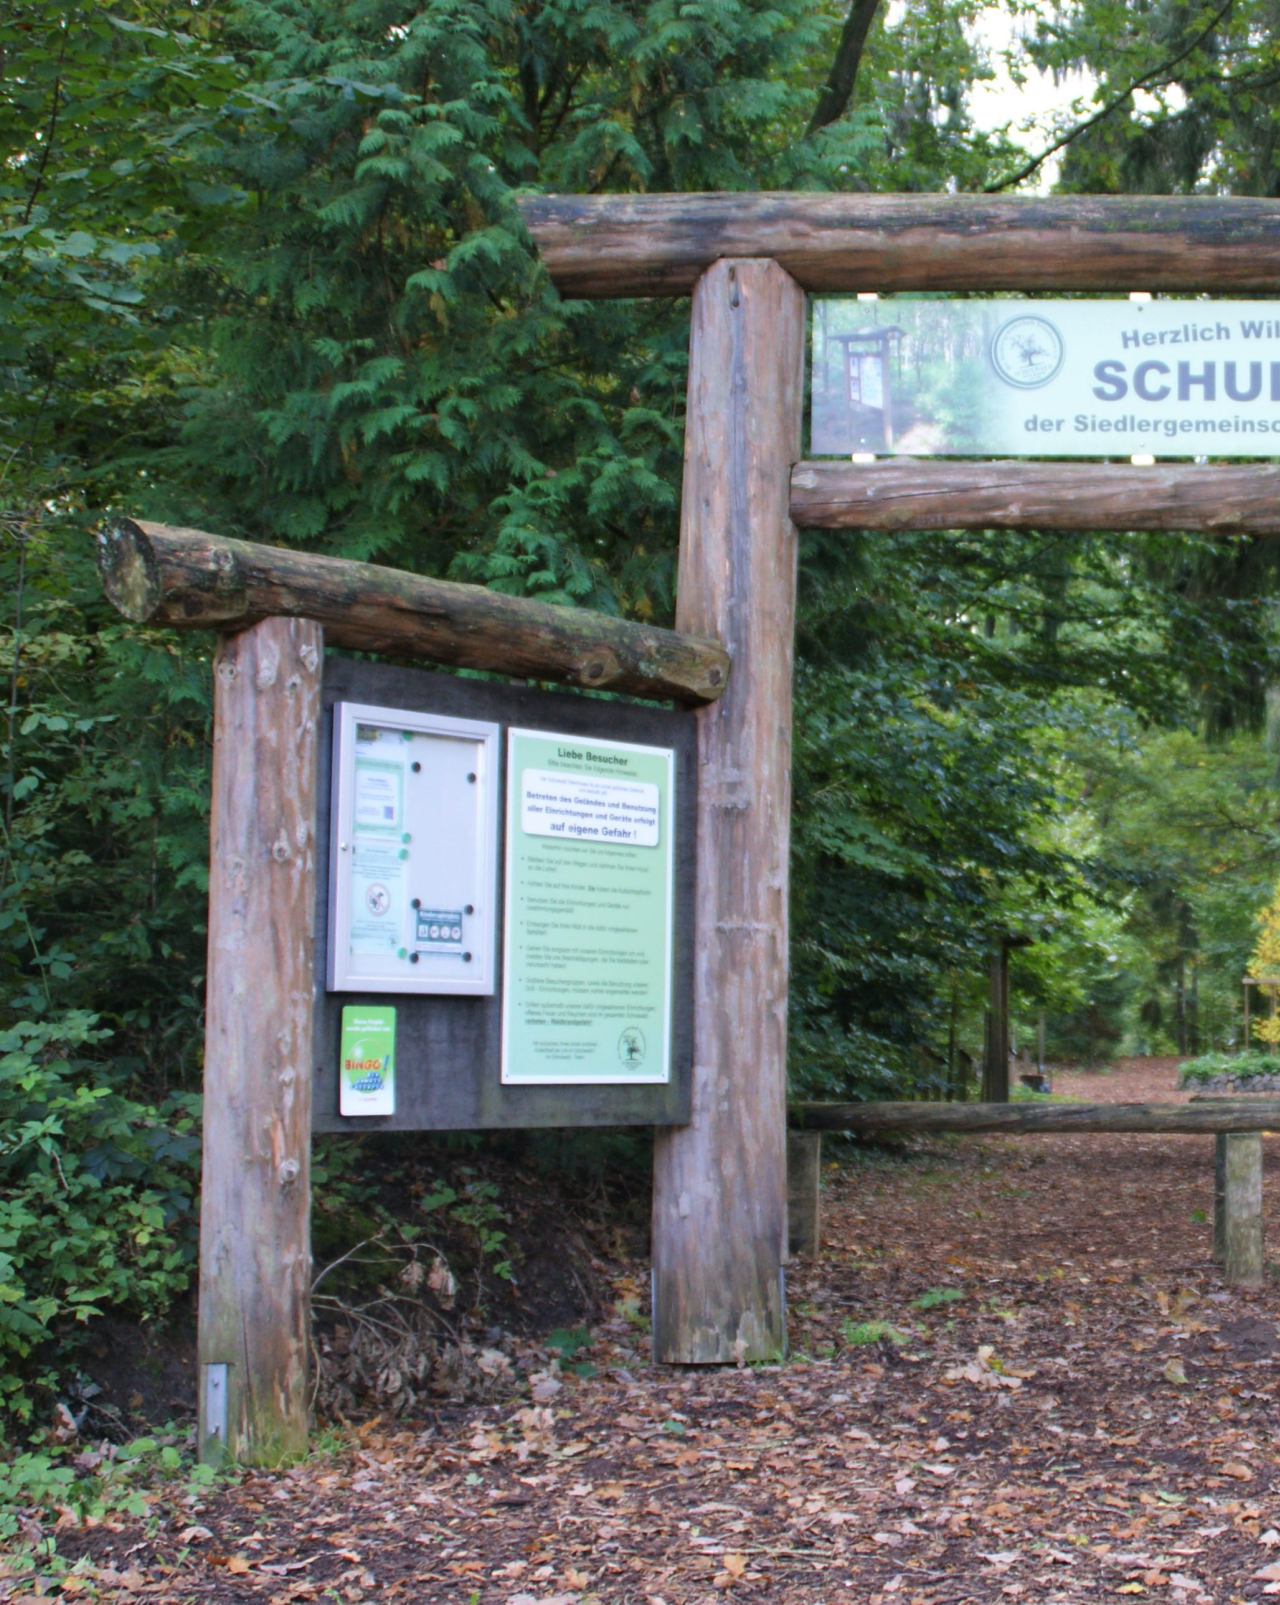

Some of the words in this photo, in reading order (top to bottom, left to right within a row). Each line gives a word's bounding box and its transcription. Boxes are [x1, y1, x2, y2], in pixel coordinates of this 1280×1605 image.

[1121, 321, 1231, 349] Herzlich
[1024, 413, 1066, 434] der
[557, 748, 583, 760] Liebe
[586, 751, 628, 766] Besucher
[526, 791, 557, 801] Betreten
[574, 797, 605, 807] Geländes
[607, 801, 620, 809] und
[622, 802, 656, 814] Benutzung
[527, 805, 543, 813] aller
[545, 806, 593, 819] Einrichtungen
[595, 812, 607, 820] und
[609, 813, 632, 823] Geräte
[634, 817, 655, 827] erfolgt
[550, 822, 565, 831] auf
[568, 824, 599, 835] eigene
[602, 827, 631, 839] Gefahr
[345, 1059, 380, 1070] BINGO
